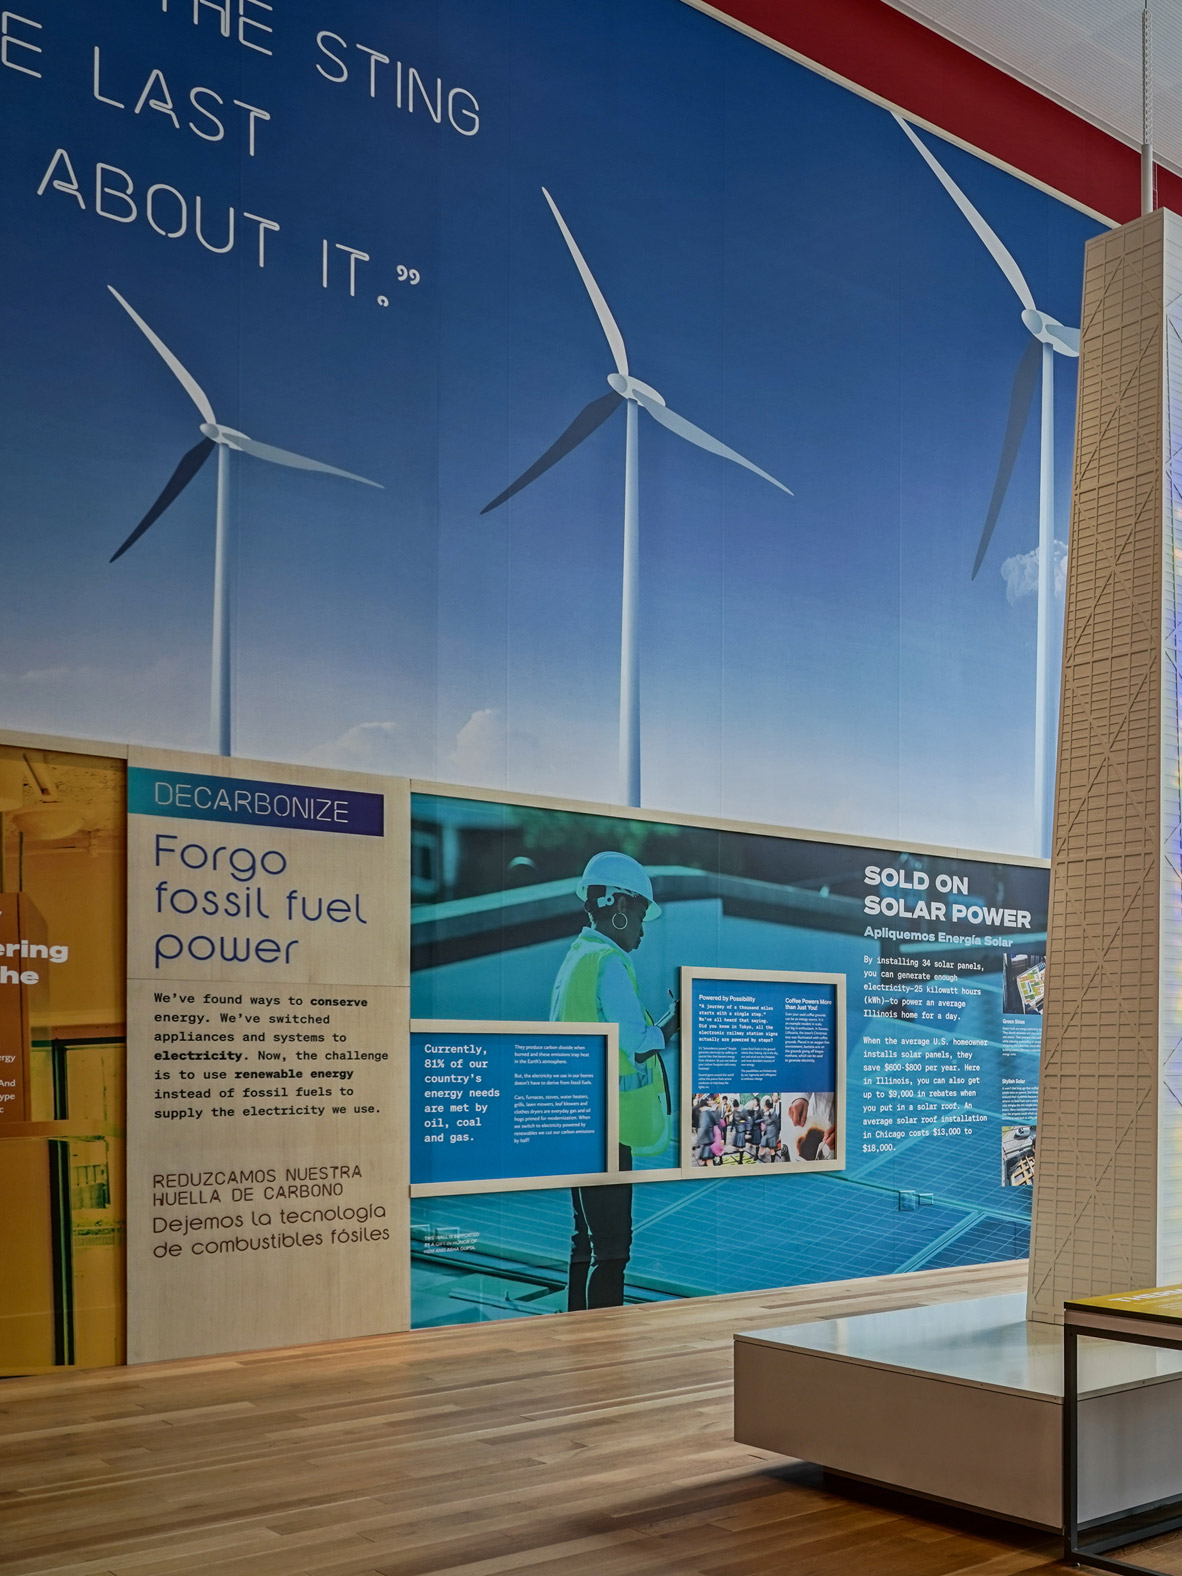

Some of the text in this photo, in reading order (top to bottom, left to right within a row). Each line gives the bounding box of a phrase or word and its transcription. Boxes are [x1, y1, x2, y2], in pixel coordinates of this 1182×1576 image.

[162, 0, 480, 136] HE STING
[94, 46, 271, 156] LAST
[37, 148, 281, 267] ABOUT
[155, 782, 349, 823] DECARBONIZE
[155, 834, 287, 882] Forgo
[864, 866, 968, 895] SOLD ON
[155, 881, 367, 924] fossil fuel
[864, 895, 1031, 928] SOLAR POWER
[864, 926, 1013, 948] Apliquemos Energía Solar
[0, 939, 69, 964] ring
[155, 934, 299, 969] power
[864, 956, 984, 972] By installing 34 solar panels,
[864, 970, 877, 978] you
[898, 972, 930, 981] generate
[934, 974, 958, 982] enough
[927, 987, 958, 995] kilowatt
[154, 993, 368, 1007] We’ve found ways to conserve
[902, 999, 922, 1007] power
[154, 1013, 330, 1024] energy. We’ve switched
[863, 1010, 898, 1018] Illinois
[946, 1012, 961, 1021] day.
[154, 1032, 347, 1043] appliances and systems to
[953, 1038, 988, 1046] homeowner
[424, 1044, 487, 1055] Currently,
[864, 1050, 897, 1058] installs
[925, 1051, 953, 1059] panels,
[957, 1051, 972, 1059] they
[154, 1051, 389, 1062] electricity. Now, the challenge
[424, 1059, 444, 1068] 81%
[450, 1059, 463, 1068] of
[154, 1069, 354, 1080] is to use renewable energy
[424, 1074, 482, 1084] country’s
[864, 1077, 872, 1085] in
[876, 1077, 913, 1085] Illinois,
[968, 1077, 980, 1085] get
[154, 1087, 354, 1099] instead of fossil fuels to
[424, 1088, 500, 1099] energy needs
[889, 1090, 913, 1098] $9,000
[154, 1105, 381, 1120] supply the electricity we use.
[450, 1103, 469, 1112] met
[475, 1103, 488, 1113] by
[863, 1105, 876, 1113] you
[880, 1104, 893, 1112] put
[941, 1102, 960, 1110] roof.
[424, 1117, 482, 1128] oil, coal
[863, 1118, 893, 1126] average
[897, 1116, 918, 1124] solar
[941, 1114, 988, 1122] installation
[424, 1133, 474, 1143] and gas.
[863, 1131, 872, 1139] in
[875, 1130, 905, 1139] Chicago
[153, 1165, 362, 1188] REDUZCAMOS NUESTRA
[153, 1183, 343, 1206] HUELLA DE CARBONO
[153, 1204, 386, 1236] Dejemos la tecnología
[153, 1227, 389, 1258] de combustibles fósiles
